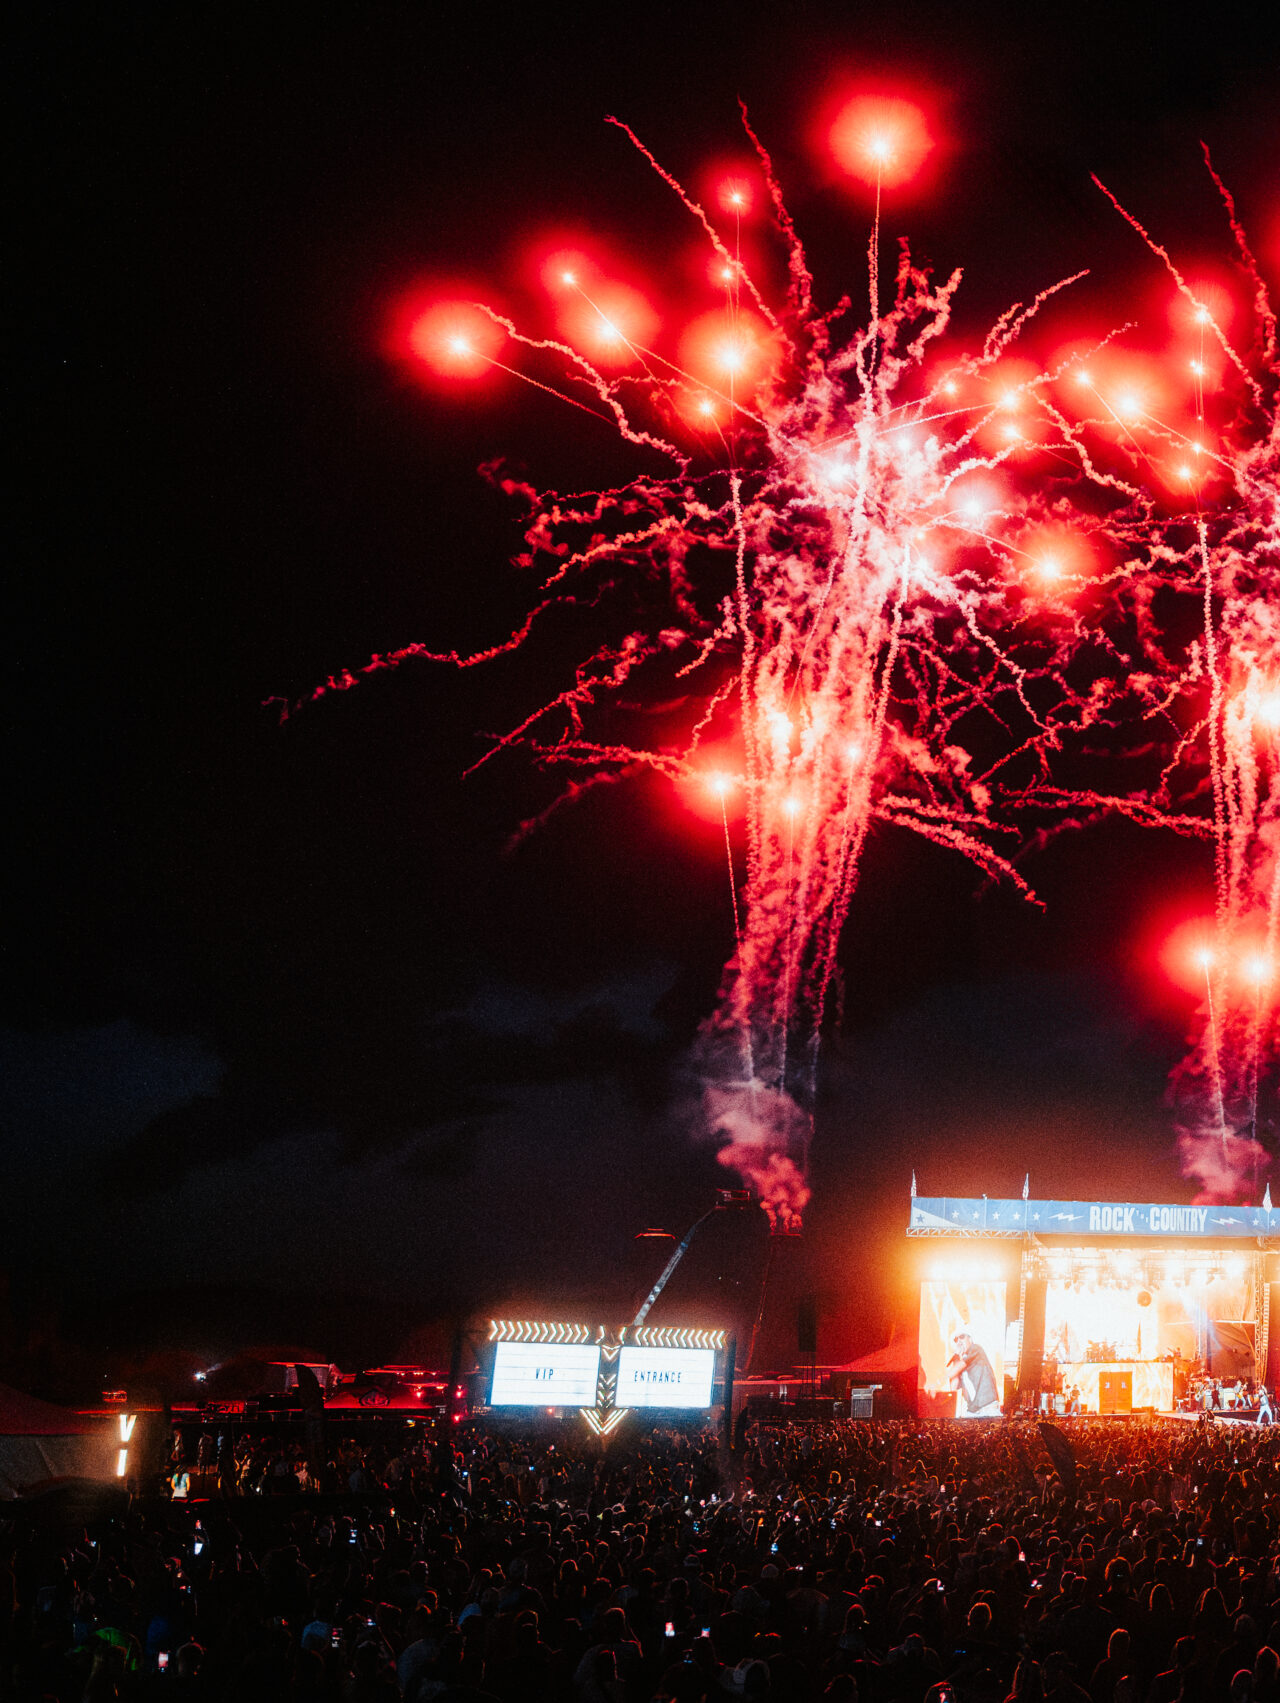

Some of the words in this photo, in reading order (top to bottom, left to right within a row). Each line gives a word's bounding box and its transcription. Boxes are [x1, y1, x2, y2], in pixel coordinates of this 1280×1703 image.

[1089, 1206, 1135, 1232] ROCK
[1149, 1206, 1208, 1233] COUNTRY
[536, 1368, 554, 1380] VIP
[634, 1370, 681, 1383] ENTRANCE
